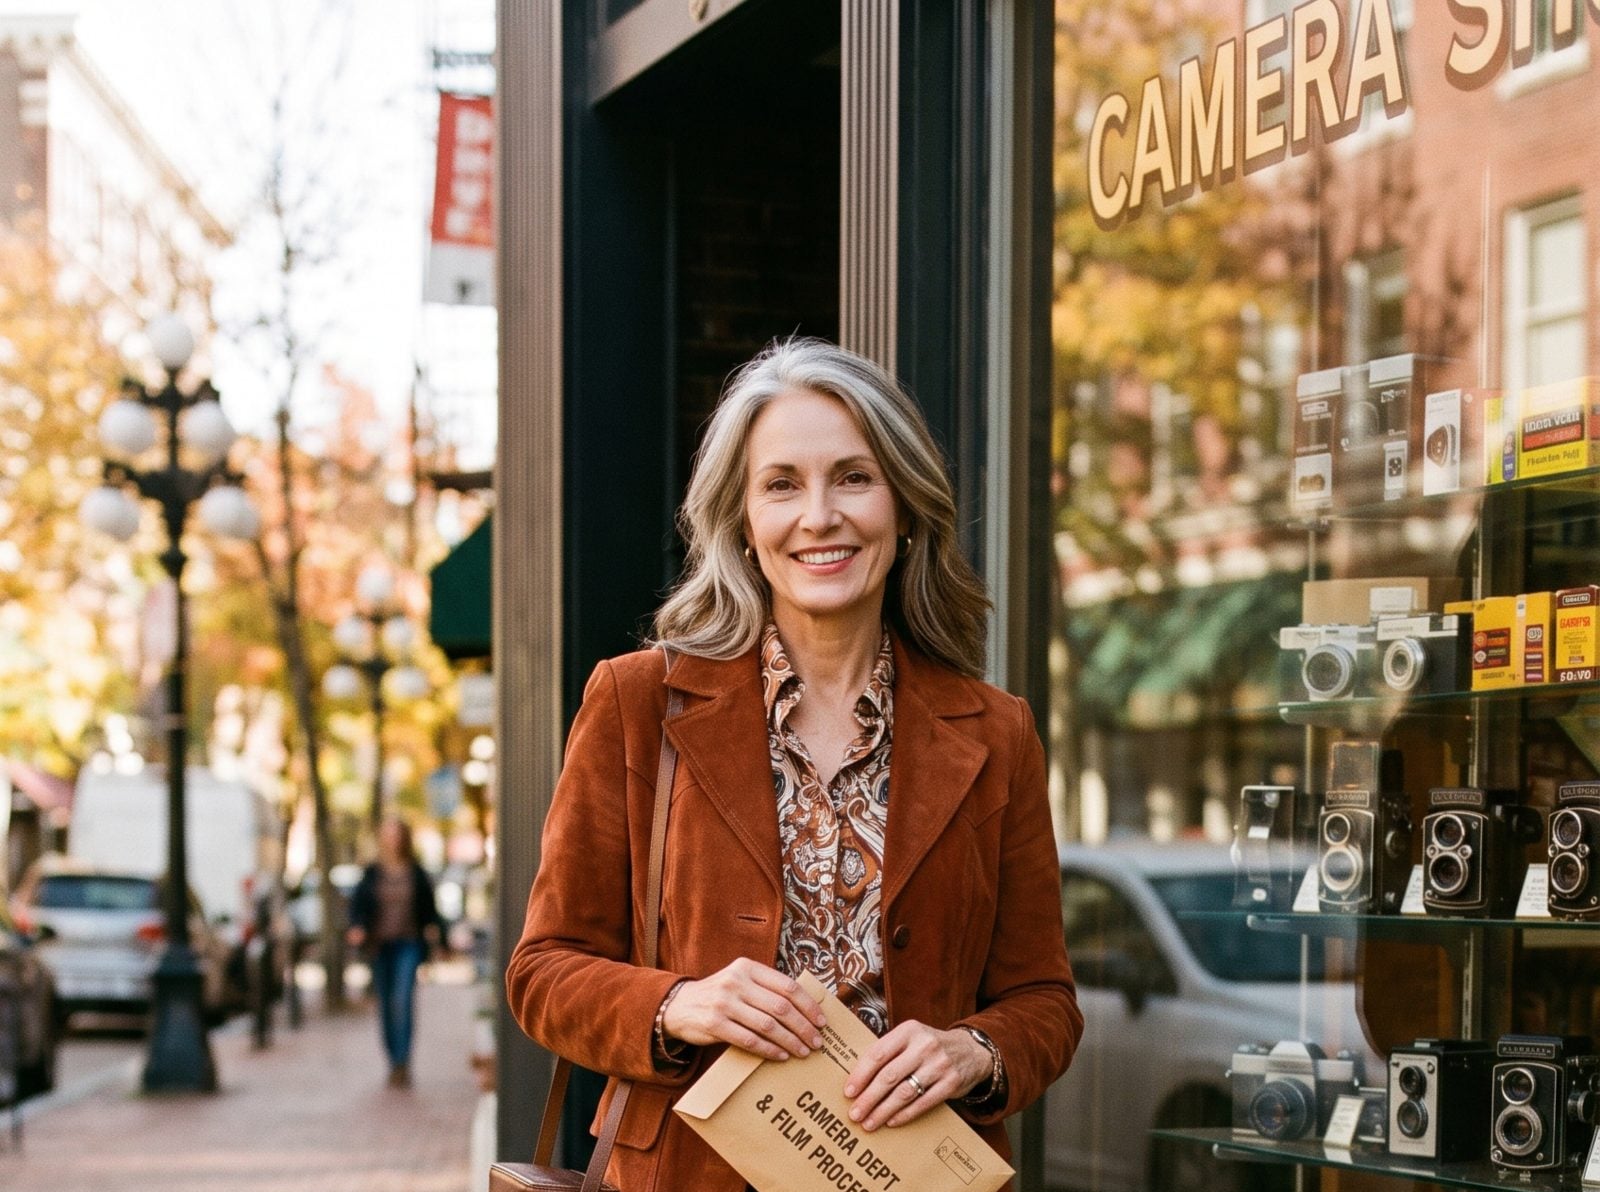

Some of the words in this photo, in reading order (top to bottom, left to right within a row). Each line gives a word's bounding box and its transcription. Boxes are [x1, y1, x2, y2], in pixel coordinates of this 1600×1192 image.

[1087, 0, 1406, 230] CAMERA
[755, 1094, 774, 1114] &
[770, 1107, 813, 1151] FILM
[796, 1090, 860, 1156] CAMERA
